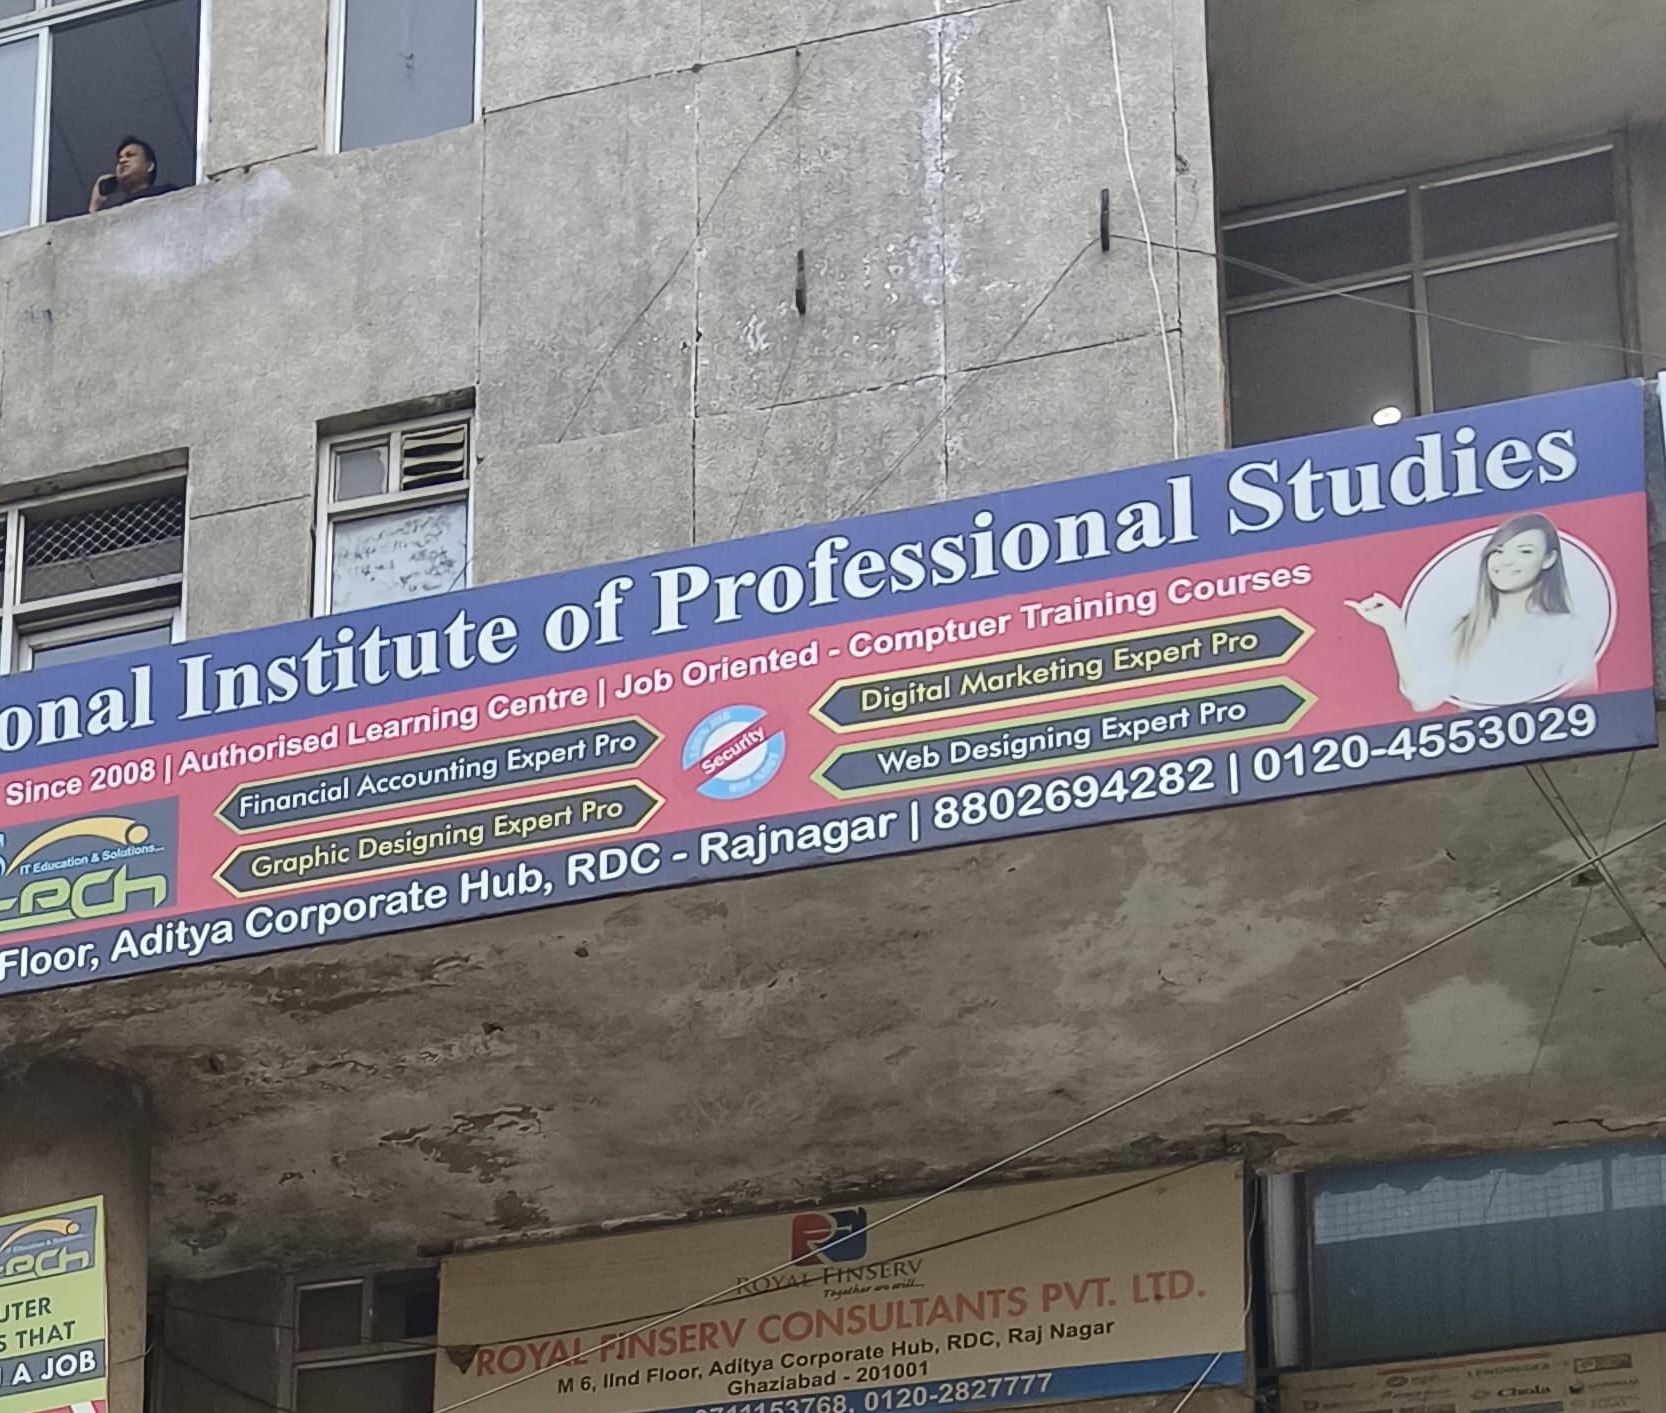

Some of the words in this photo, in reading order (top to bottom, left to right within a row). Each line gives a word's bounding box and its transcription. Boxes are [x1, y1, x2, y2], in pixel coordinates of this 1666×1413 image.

[178, 607, 519, 720] Institute
[545, 577, 634, 651] of
[652, 475, 1197, 636] Professional
[1226, 425, 1579, 536] Studies
[4, 774, 84, 807] Since
[90, 757, 157, 793] 2008
[179, 721, 338, 778] Authorised
[348, 701, 479, 748] Learning
[488, 685, 590, 721] Centre
[615, 669, 674, 698] Job
[682, 637, 821, 687] Oriented
[1020, 584, 1157, 632] Training
[1166, 563, 1312, 607] Courses
[239, 777, 351, 818] Financial
[357, 751, 499, 800] Accounting
[505, 735, 588, 779] Expert
[595, 729, 637, 757] Pro
[701, 727, 765, 774] Security
[33, 854, 88, 874] Education
[110, 914, 235, 964] Aditya
[244, 877, 448, 941] Corporate
[458, 862, 554, 909] Hub,
[567, 842, 661, 886] RDC
[699, 810, 897, 868] Rajnagar
[934, 757, 1215, 831] 8802694282
[1253, 703, 1596, 782] 0120-4553029
[474, 1336, 587, 1376] ROYAL
[599, 1319, 748, 1362] FINSERV
[758, 1288, 1028, 1344] CONSULTANTS
[1042, 1280, 1117, 1309] PVT.
[1133, 1270, 1207, 1303] LTD.
[558, 1374, 575, 1393] M
[581, 1374, 597, 1393] 6,
[646, 1362, 704, 1386] Floor,
[709, 1355, 775, 1378] Aditya
[781, 1344, 883, 1374] Corporate
[889, 1336, 941, 1360] Hub,
[947, 1328, 1002, 1354] RDC,
[1008, 1323, 1043, 1348] Raj
[1050, 1319, 1115, 1345] Nagar
[727, 1371, 837, 1397] Ghaziabad
[855, 1362, 929, 1387] 201001
[863, 1373, 1052, 1413] 0120-2827777
